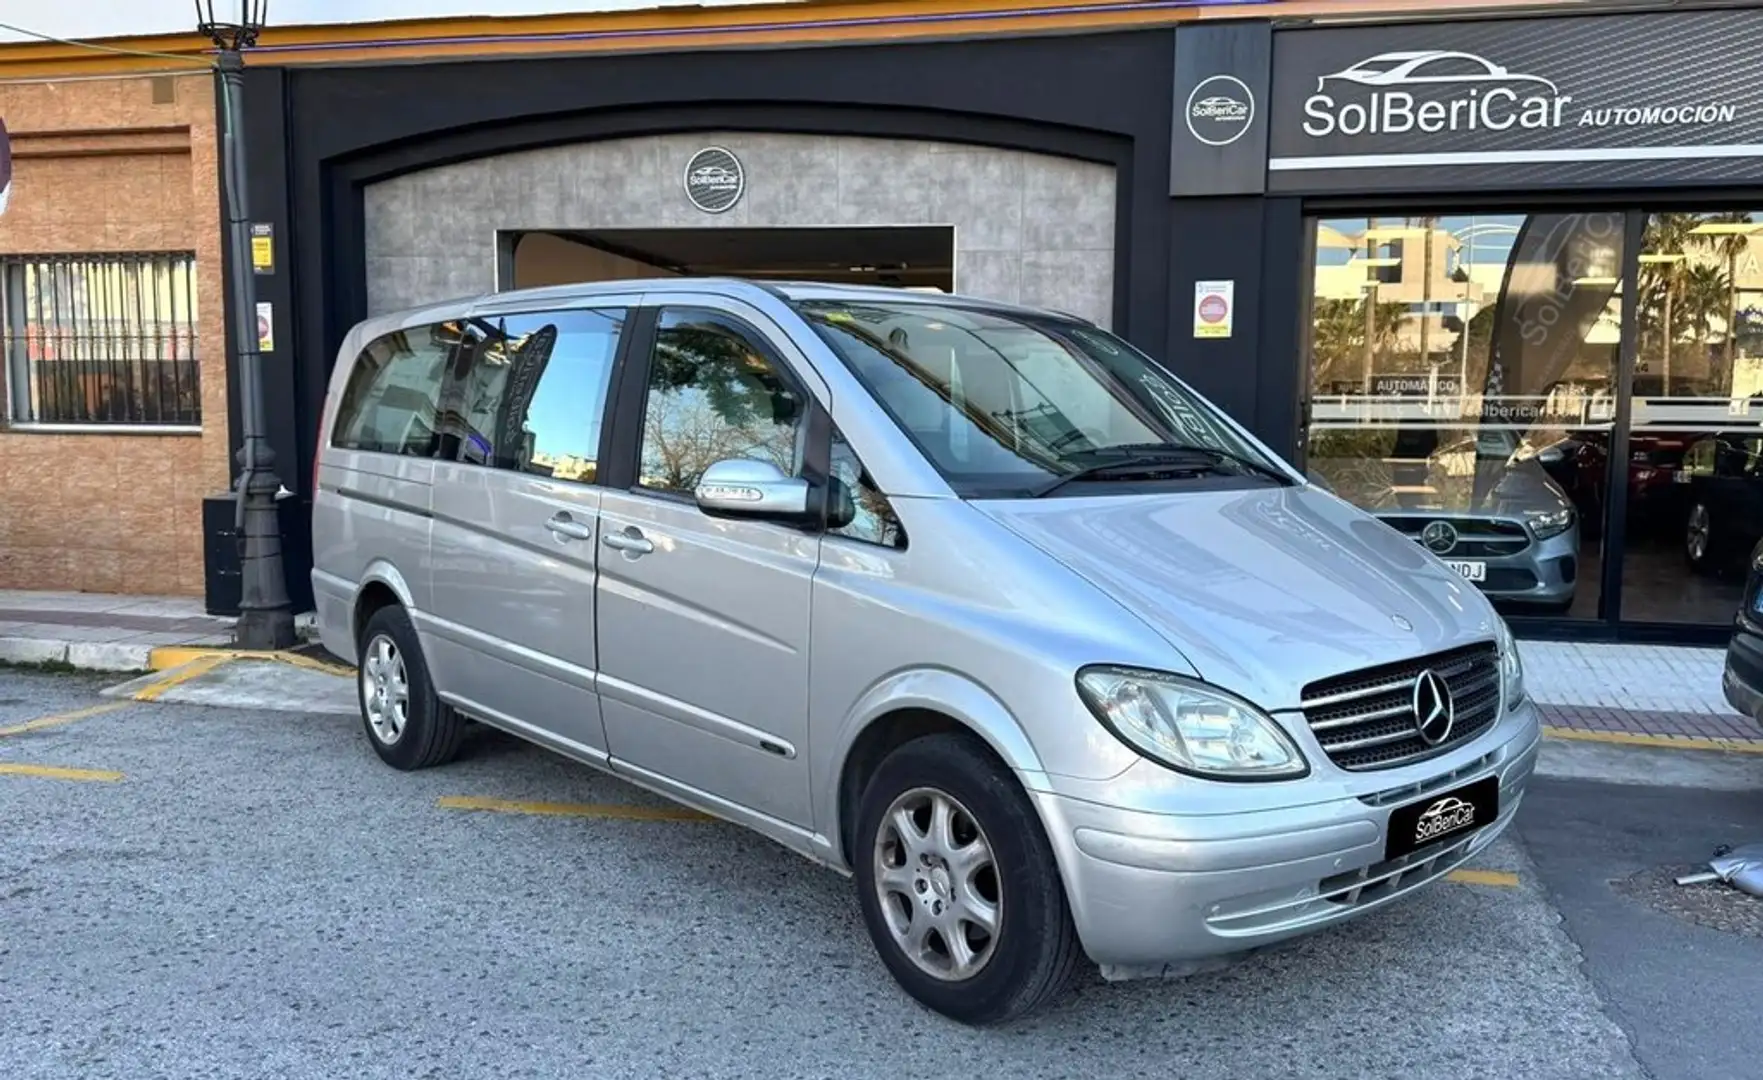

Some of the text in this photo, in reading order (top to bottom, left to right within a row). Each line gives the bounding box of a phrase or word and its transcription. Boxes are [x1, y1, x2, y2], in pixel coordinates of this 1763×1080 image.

[1302, 88, 1736, 136] SolBeriCar AUTOMOCIÓN
[1376, 379, 1454, 391] AUTOMÁCO
